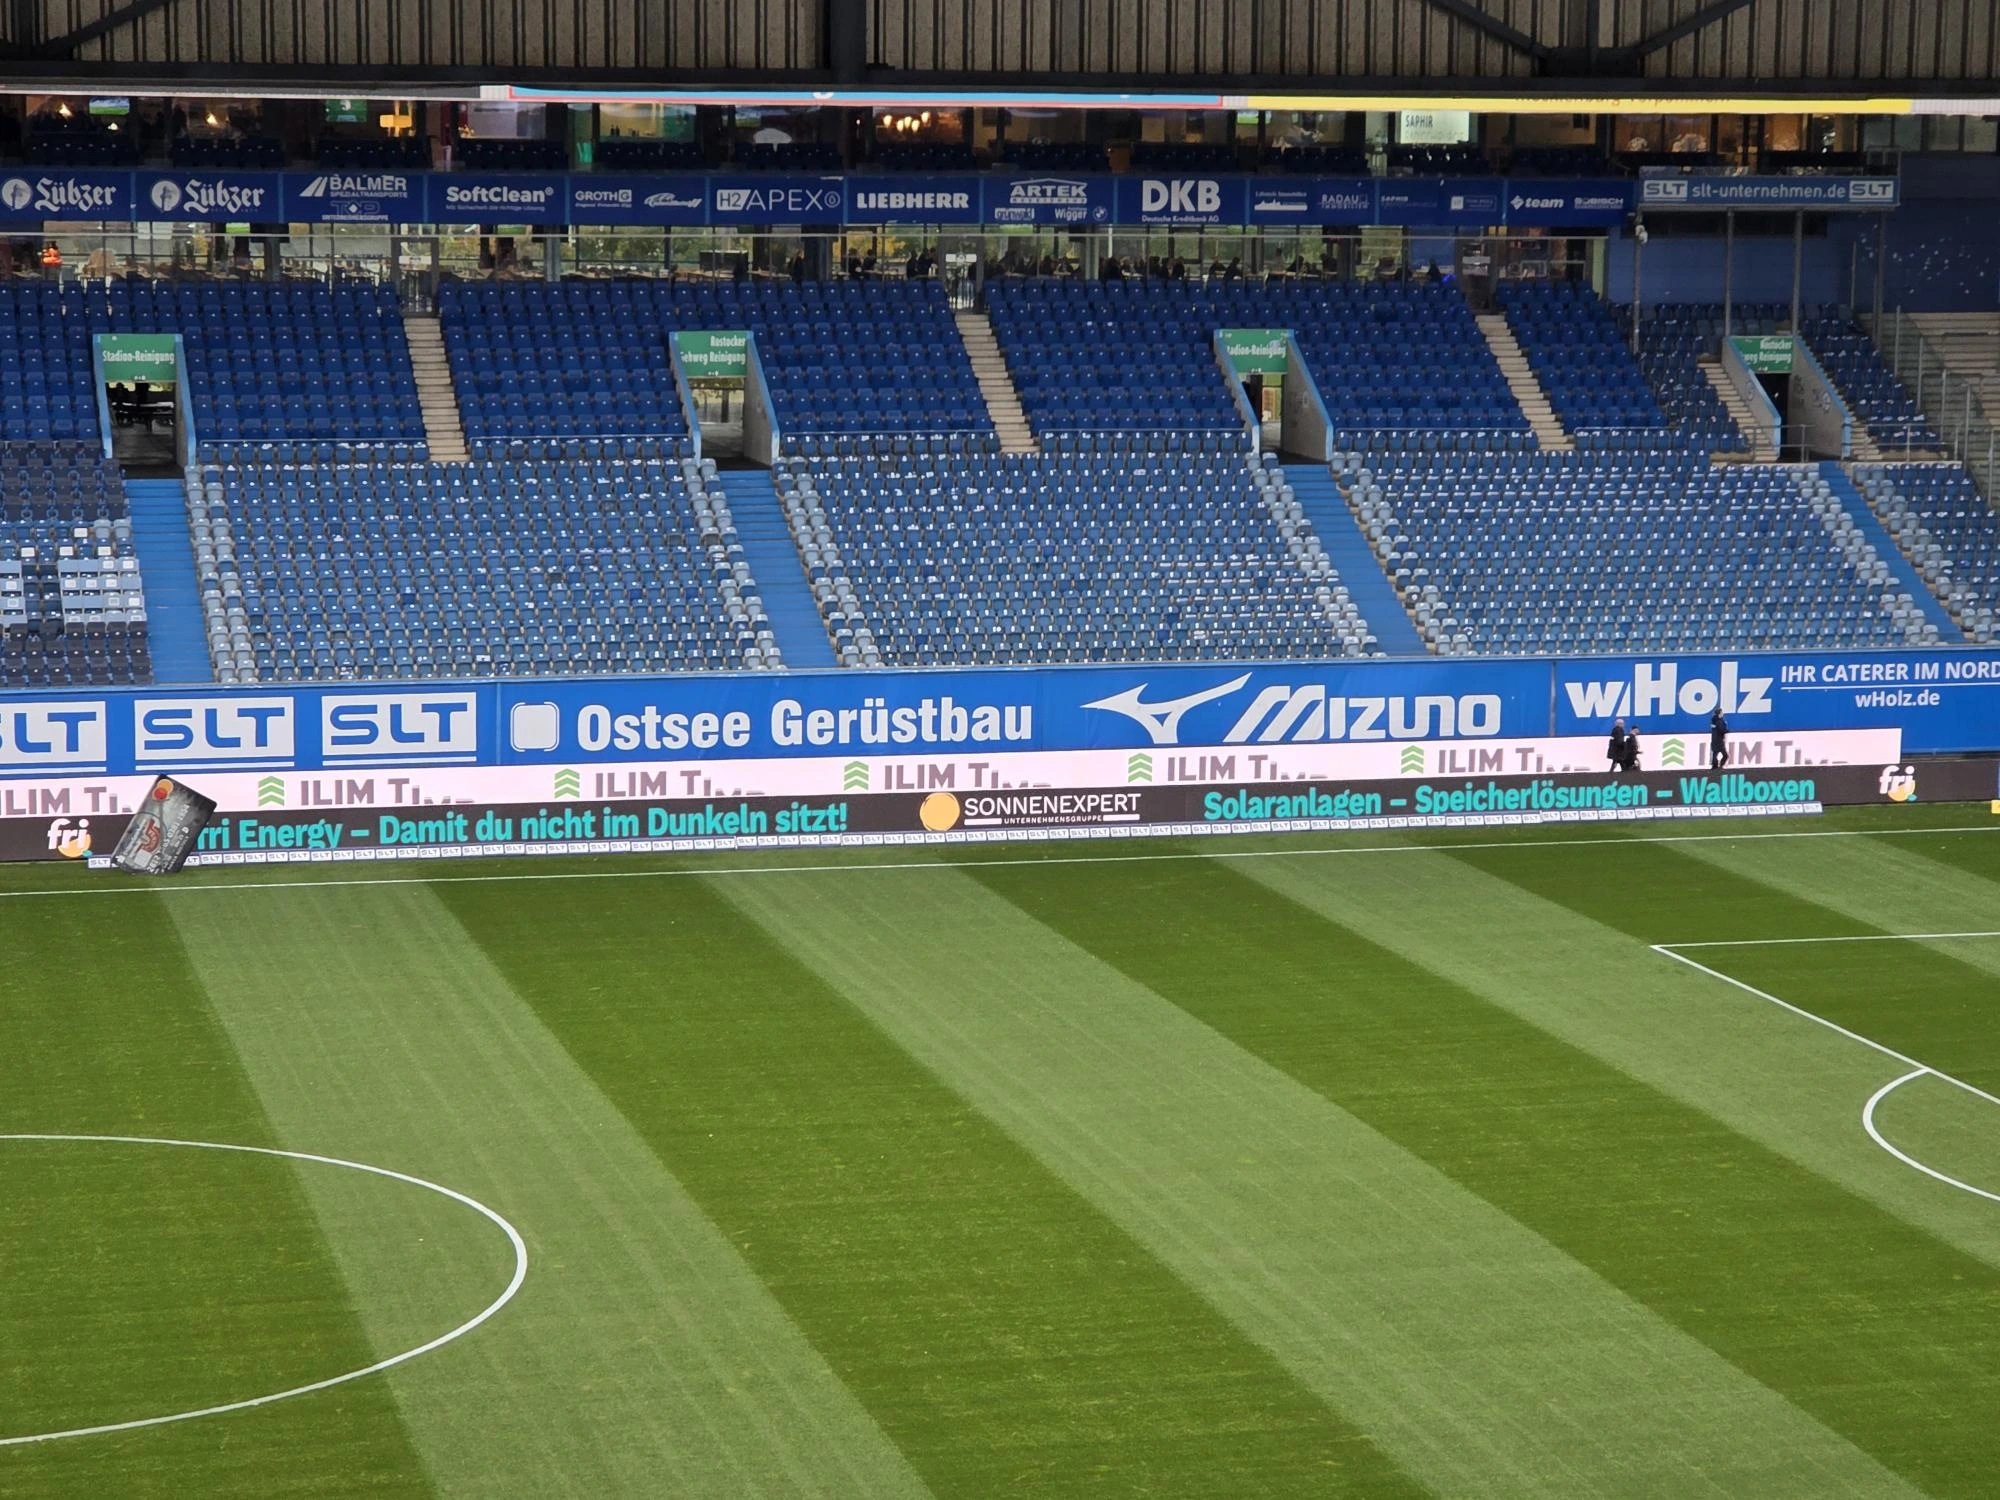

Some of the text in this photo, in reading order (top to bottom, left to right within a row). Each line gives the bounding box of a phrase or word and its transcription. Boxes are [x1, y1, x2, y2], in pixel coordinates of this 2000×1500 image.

[34, 177, 117, 212] Lübzer
[183, 179, 265, 213] Lübzer
[329, 175, 407, 191] BALMER
[575, 190, 618, 201] GROTH
[1010, 185, 1087, 197] ARTEK
[1142, 180, 1220, 212] DKB
[1645, 182, 1893, 199] SLT slt-unternehmen.de SLT
[857, 192, 969, 209] LIEBHERR
[1525, 197, 1565, 209] team
[1055, 207, 1087, 221] Wigger
[102, 349, 175, 365] Stadion-Reinigung
[1781, 665, 1816, 683] IHR
[1821, 662, 1908, 682] CATERER
[1914, 661, 1939, 680] IM
[1855, 688, 1940, 708] wHolz.de
[330, 702, 468, 746] SLT
[577, 696, 1032, 752] Ostsee Gerüstbau
[1223, 684, 1501, 743] MIZUNO
[0, 711, 97, 753] LT
[143, 706, 285, 750] SLT
[1168, 755, 1235, 781] ILIM
[1438, 748, 1503, 773] ILIM
[595, 770, 667, 798] ILIM
[884, 763, 955, 790] ILIM
[301, 778, 374, 806] ILIM
[964, 793, 1142, 817] SONNENEXPERT
[1204, 786, 1381, 821] Solaranlagen
[1415, 779, 1648, 816] Speicherlösungen
[1680, 774, 1815, 805] Wallboxen
[240, 819, 344, 849] Energy
[379, 811, 468, 845] Damit
[475, 809, 512, 842] du
[521, 807, 596, 840] nicht
[603, 806, 639, 838] im
[648, 803, 767, 836] Dunkeln
[775, 801, 847, 833] sitzt!
